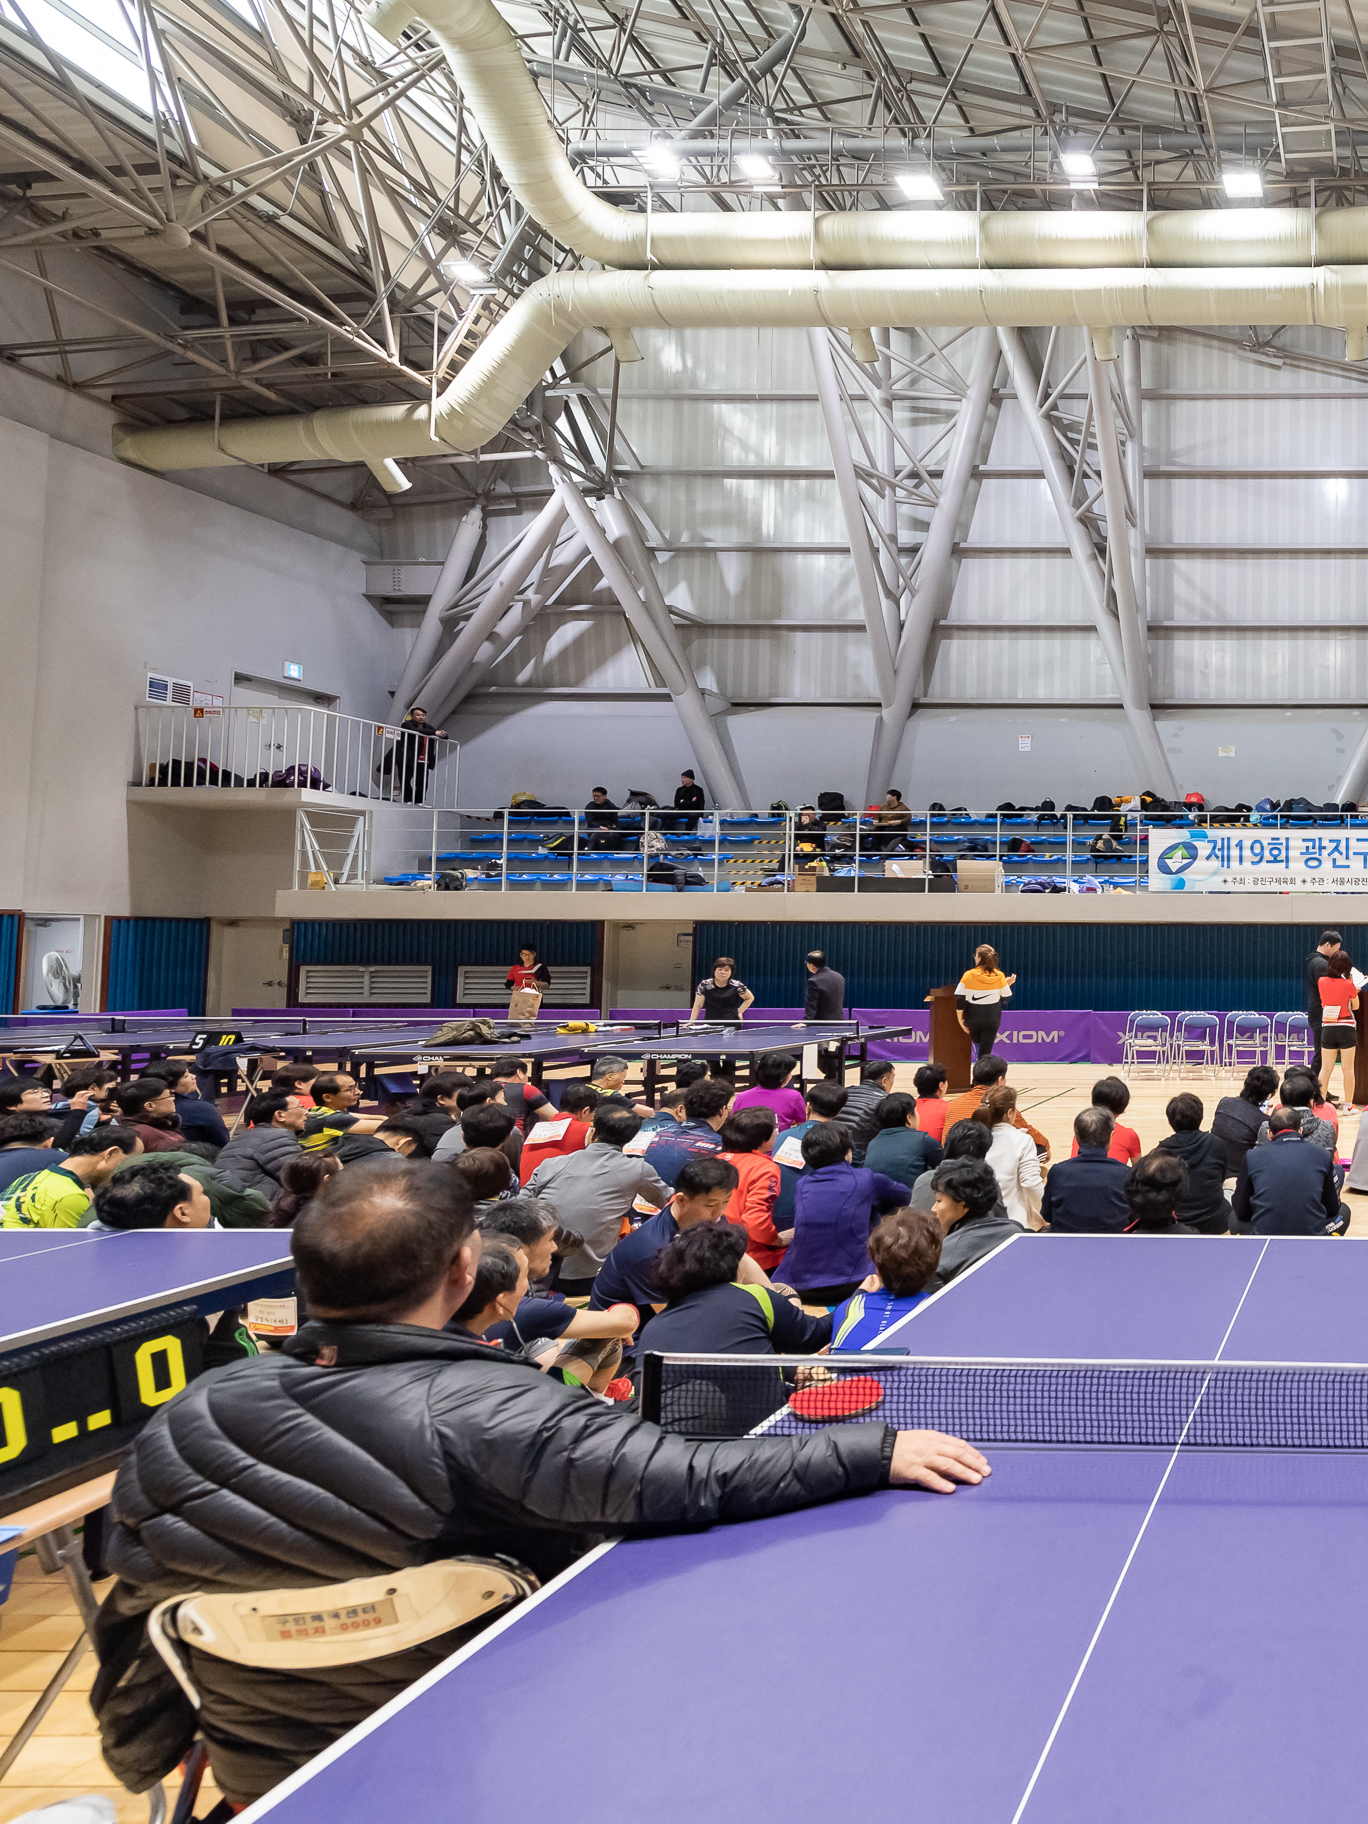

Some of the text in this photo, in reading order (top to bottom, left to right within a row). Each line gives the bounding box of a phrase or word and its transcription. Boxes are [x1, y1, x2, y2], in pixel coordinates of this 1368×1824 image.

[1205, 836, 1290, 869] 제19회
[1252, 876, 1297, 886] 광진구체육회
[1309, 876, 1325, 886] 주관
[192, 1034, 207, 1049] 5
[134, 1334, 187, 1408] 0
